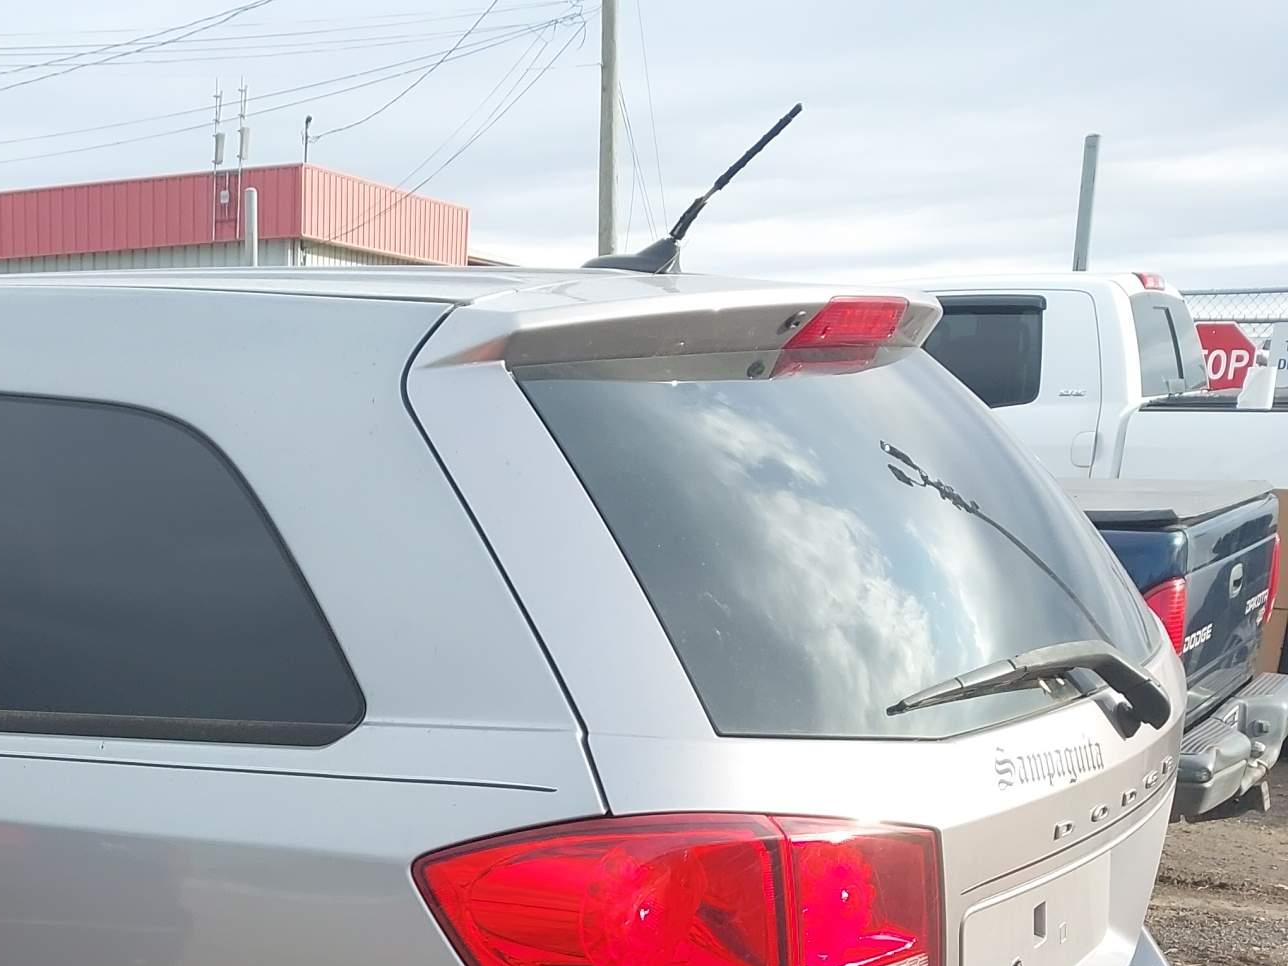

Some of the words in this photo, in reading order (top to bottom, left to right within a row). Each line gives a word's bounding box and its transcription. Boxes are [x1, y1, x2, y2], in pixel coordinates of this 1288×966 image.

[1201, 348, 1250, 380] OP
[1182, 623, 1213, 654] DODGE
[995, 736, 1105, 792] Sampaguita
[1053, 755, 1178, 841] DODGE
